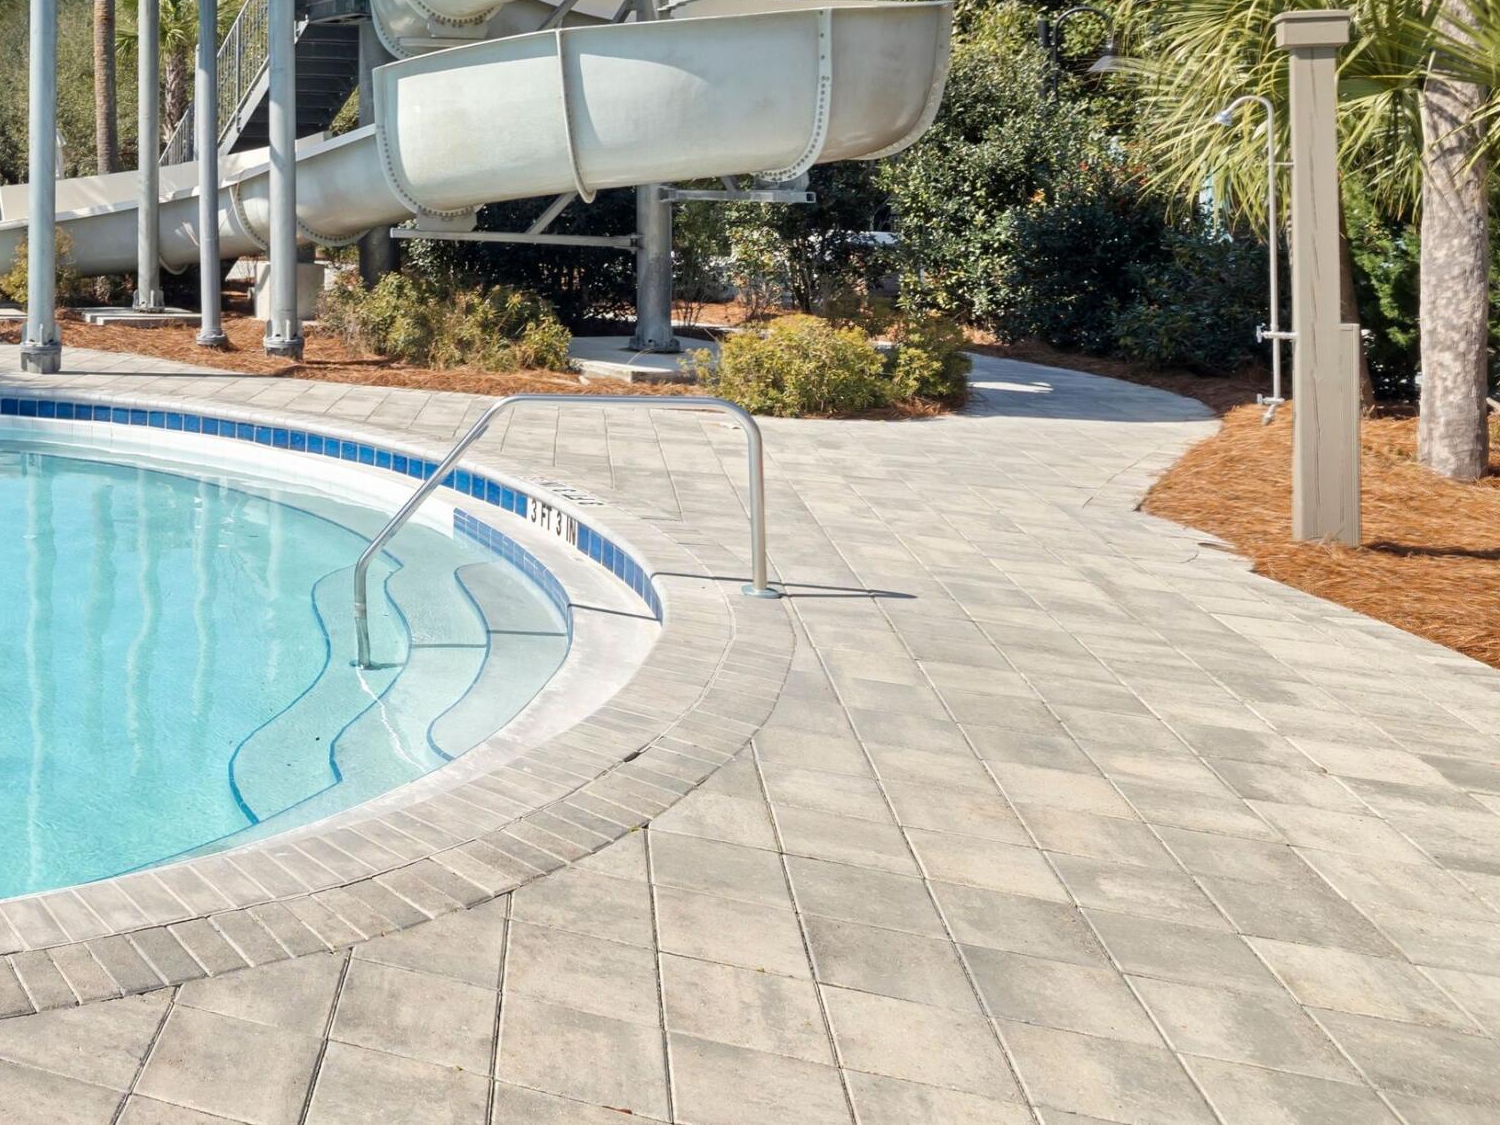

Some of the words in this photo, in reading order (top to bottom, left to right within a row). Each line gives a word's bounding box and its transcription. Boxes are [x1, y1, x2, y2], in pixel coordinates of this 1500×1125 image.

[531, 498, 537, 523] 3
[541, 502, 552, 530] FT
[556, 511, 562, 536] 3
[566, 516, 576, 545] IN
